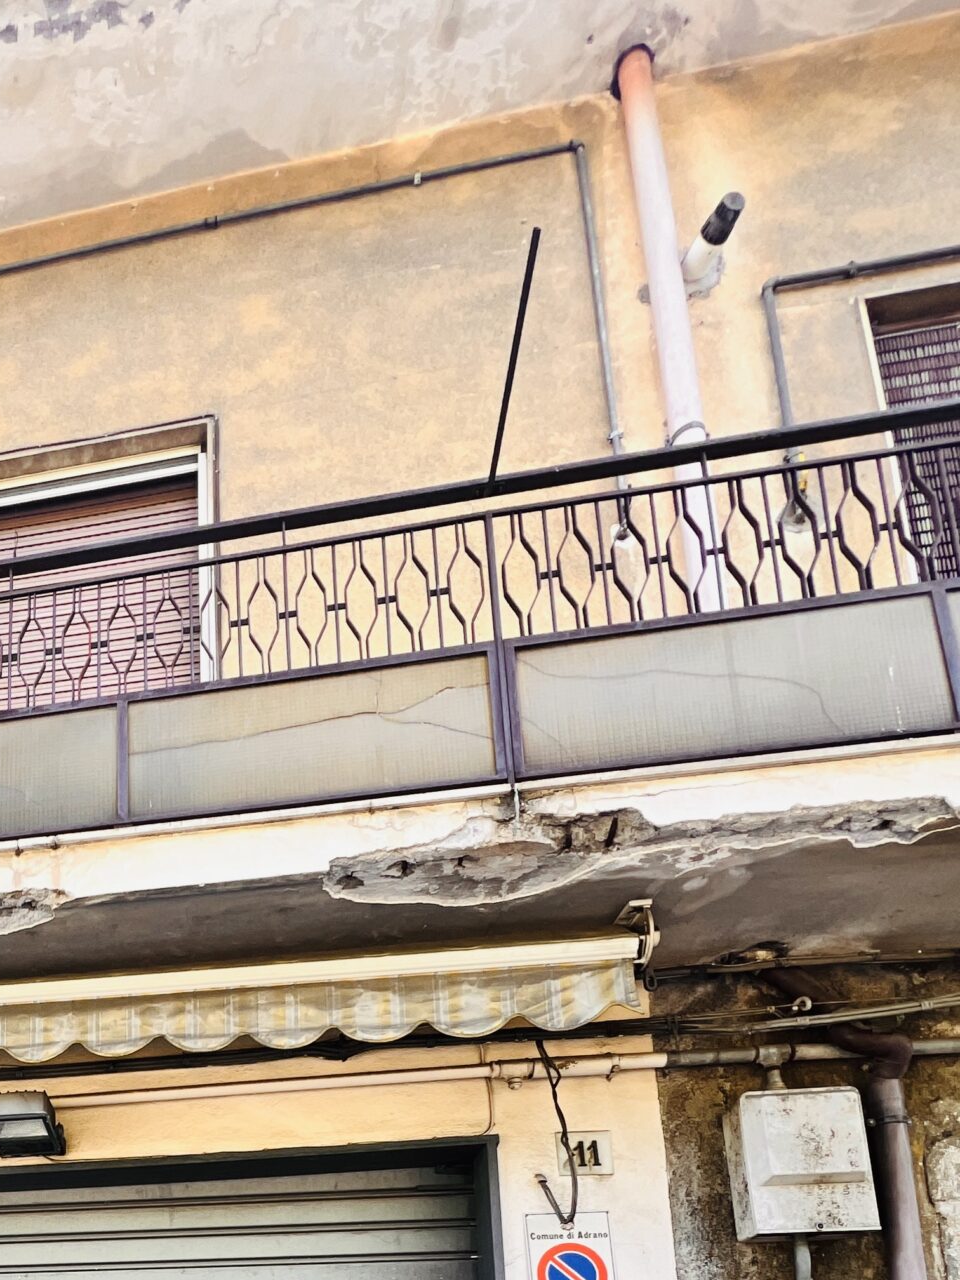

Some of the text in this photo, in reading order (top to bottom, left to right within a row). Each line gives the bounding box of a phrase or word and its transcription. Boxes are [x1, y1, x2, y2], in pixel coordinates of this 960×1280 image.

[572, 1139, 602, 1168] 11
[530, 1230, 609, 1241] Comune di Adrano
